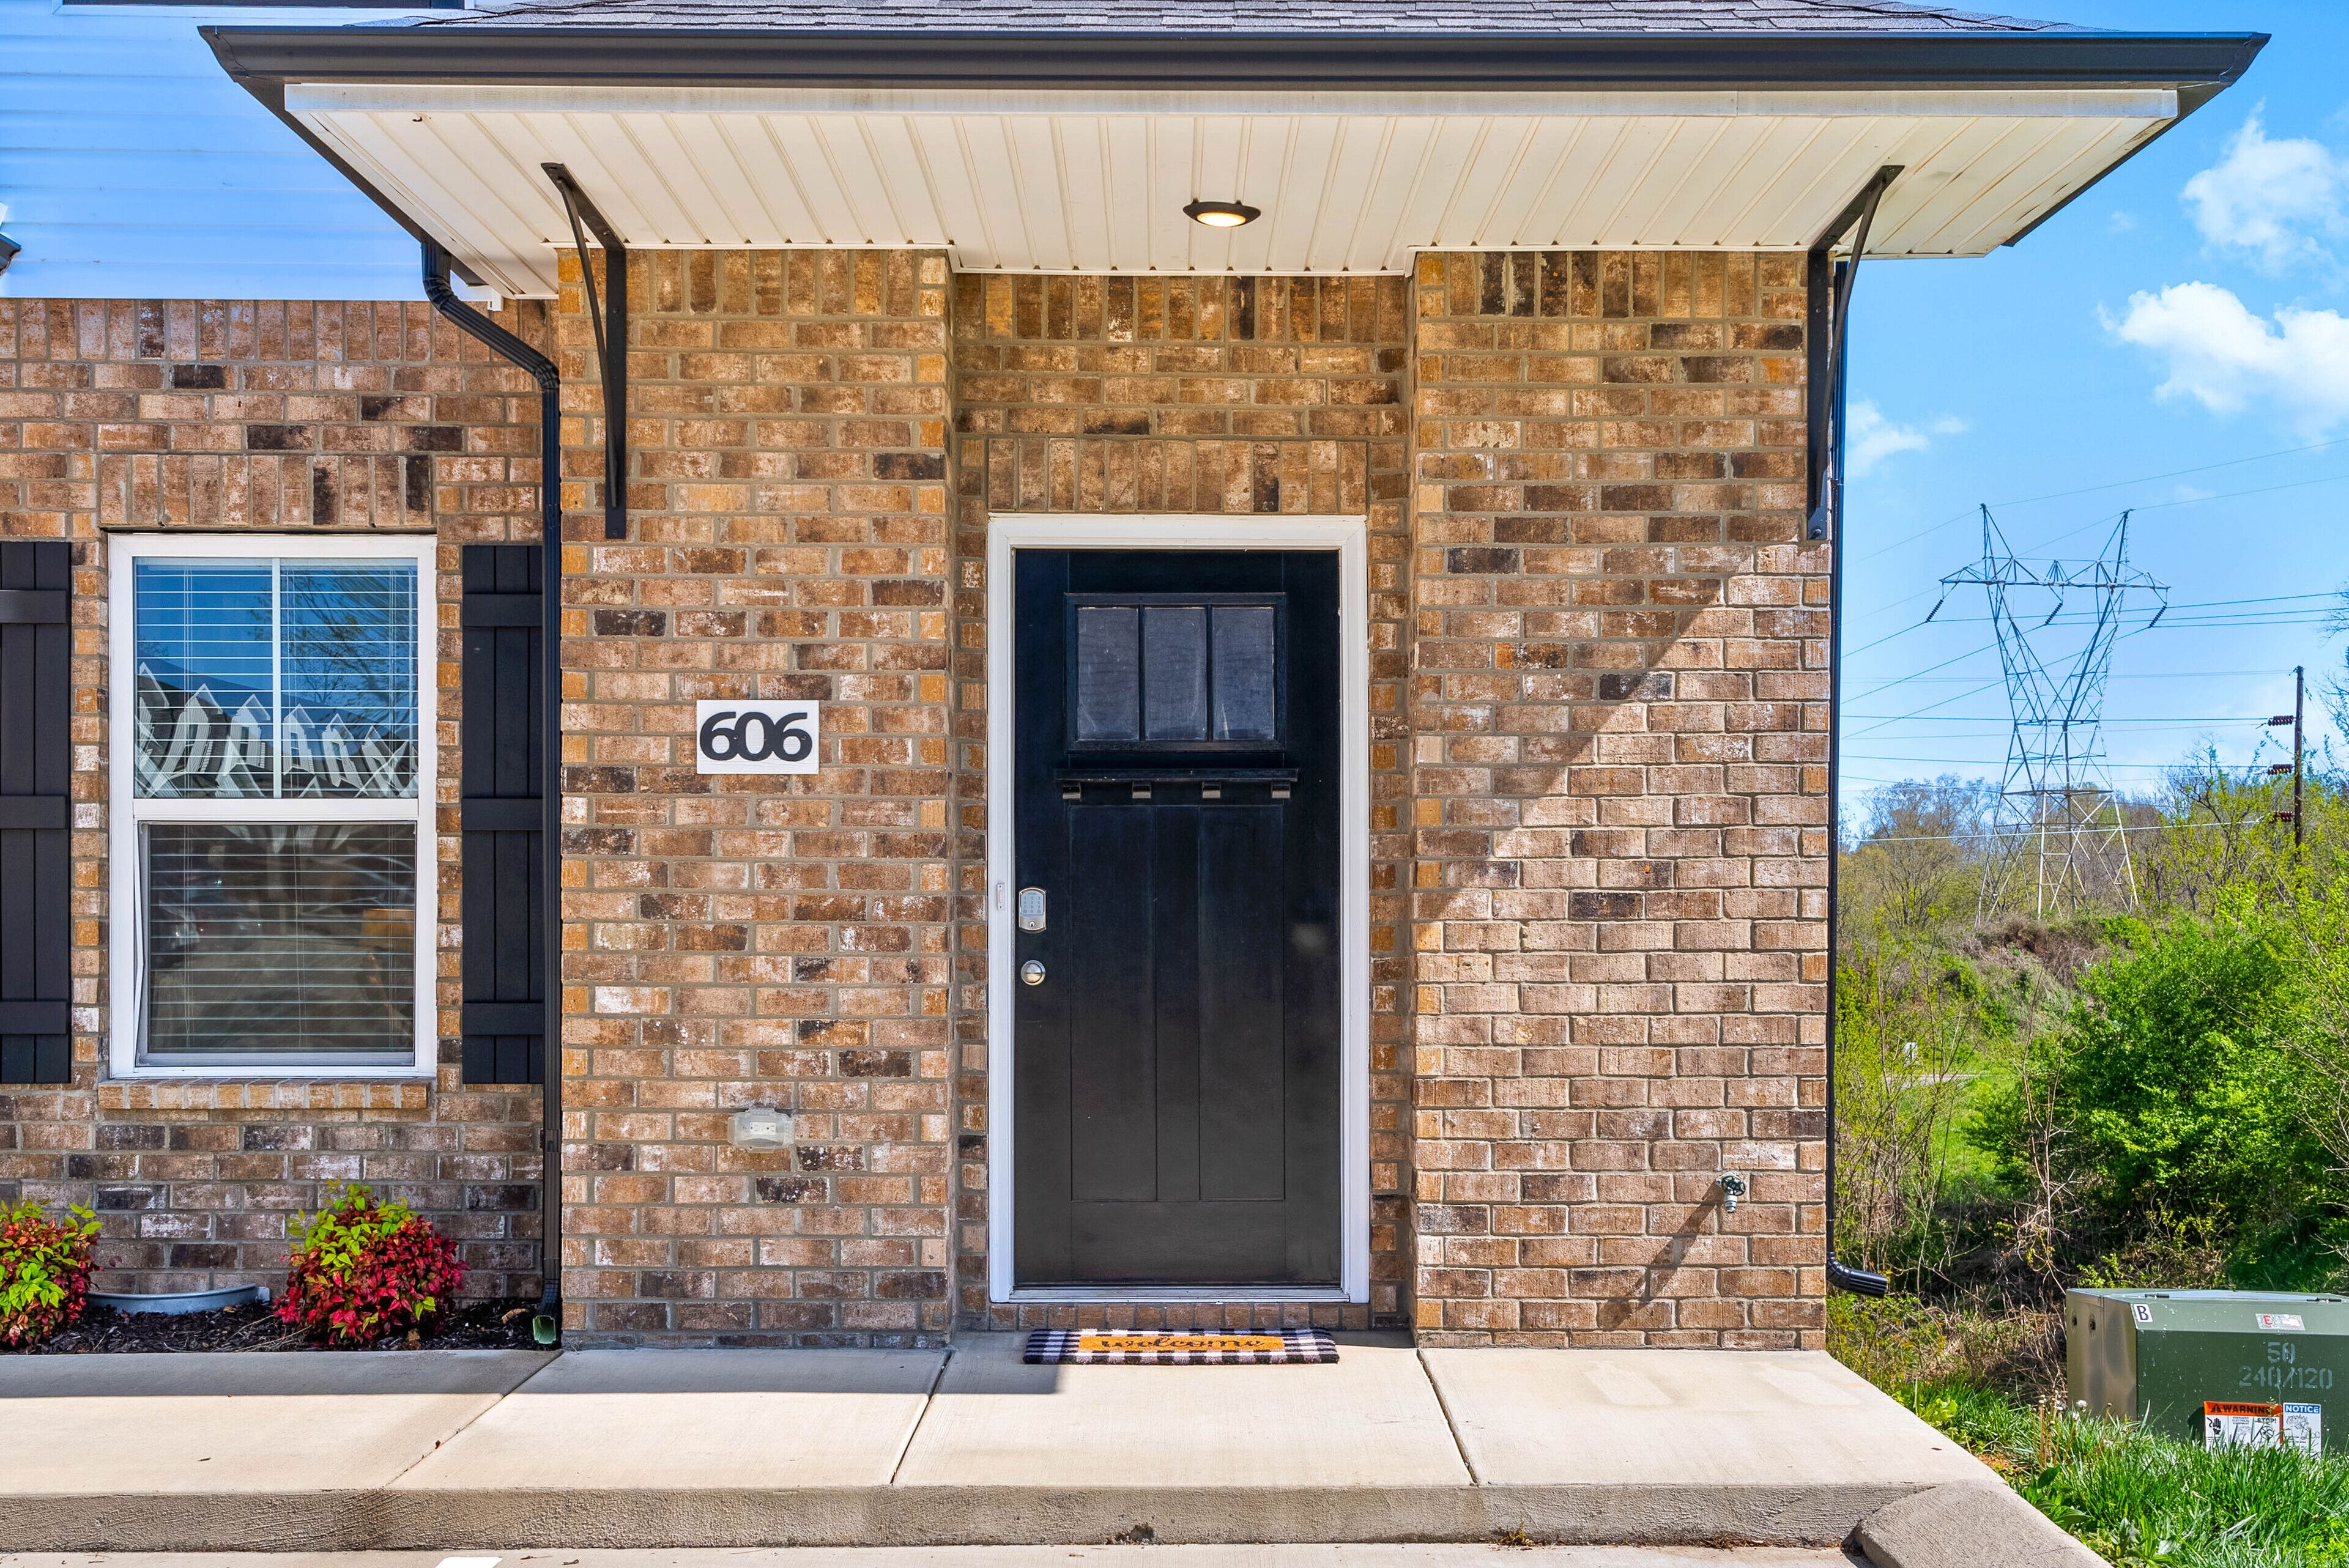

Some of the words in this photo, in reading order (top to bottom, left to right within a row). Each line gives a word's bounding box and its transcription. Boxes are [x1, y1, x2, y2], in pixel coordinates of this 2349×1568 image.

[700, 711, 812, 762] 606
[2136, 1305, 2149, 1320] B
[1101, 1336, 1265, 1348] welcome
[2268, 1342, 2295, 1364] 50
[2239, 1366, 2332, 1389] 240/120
[2285, 1405, 2319, 1413] NOTICE
